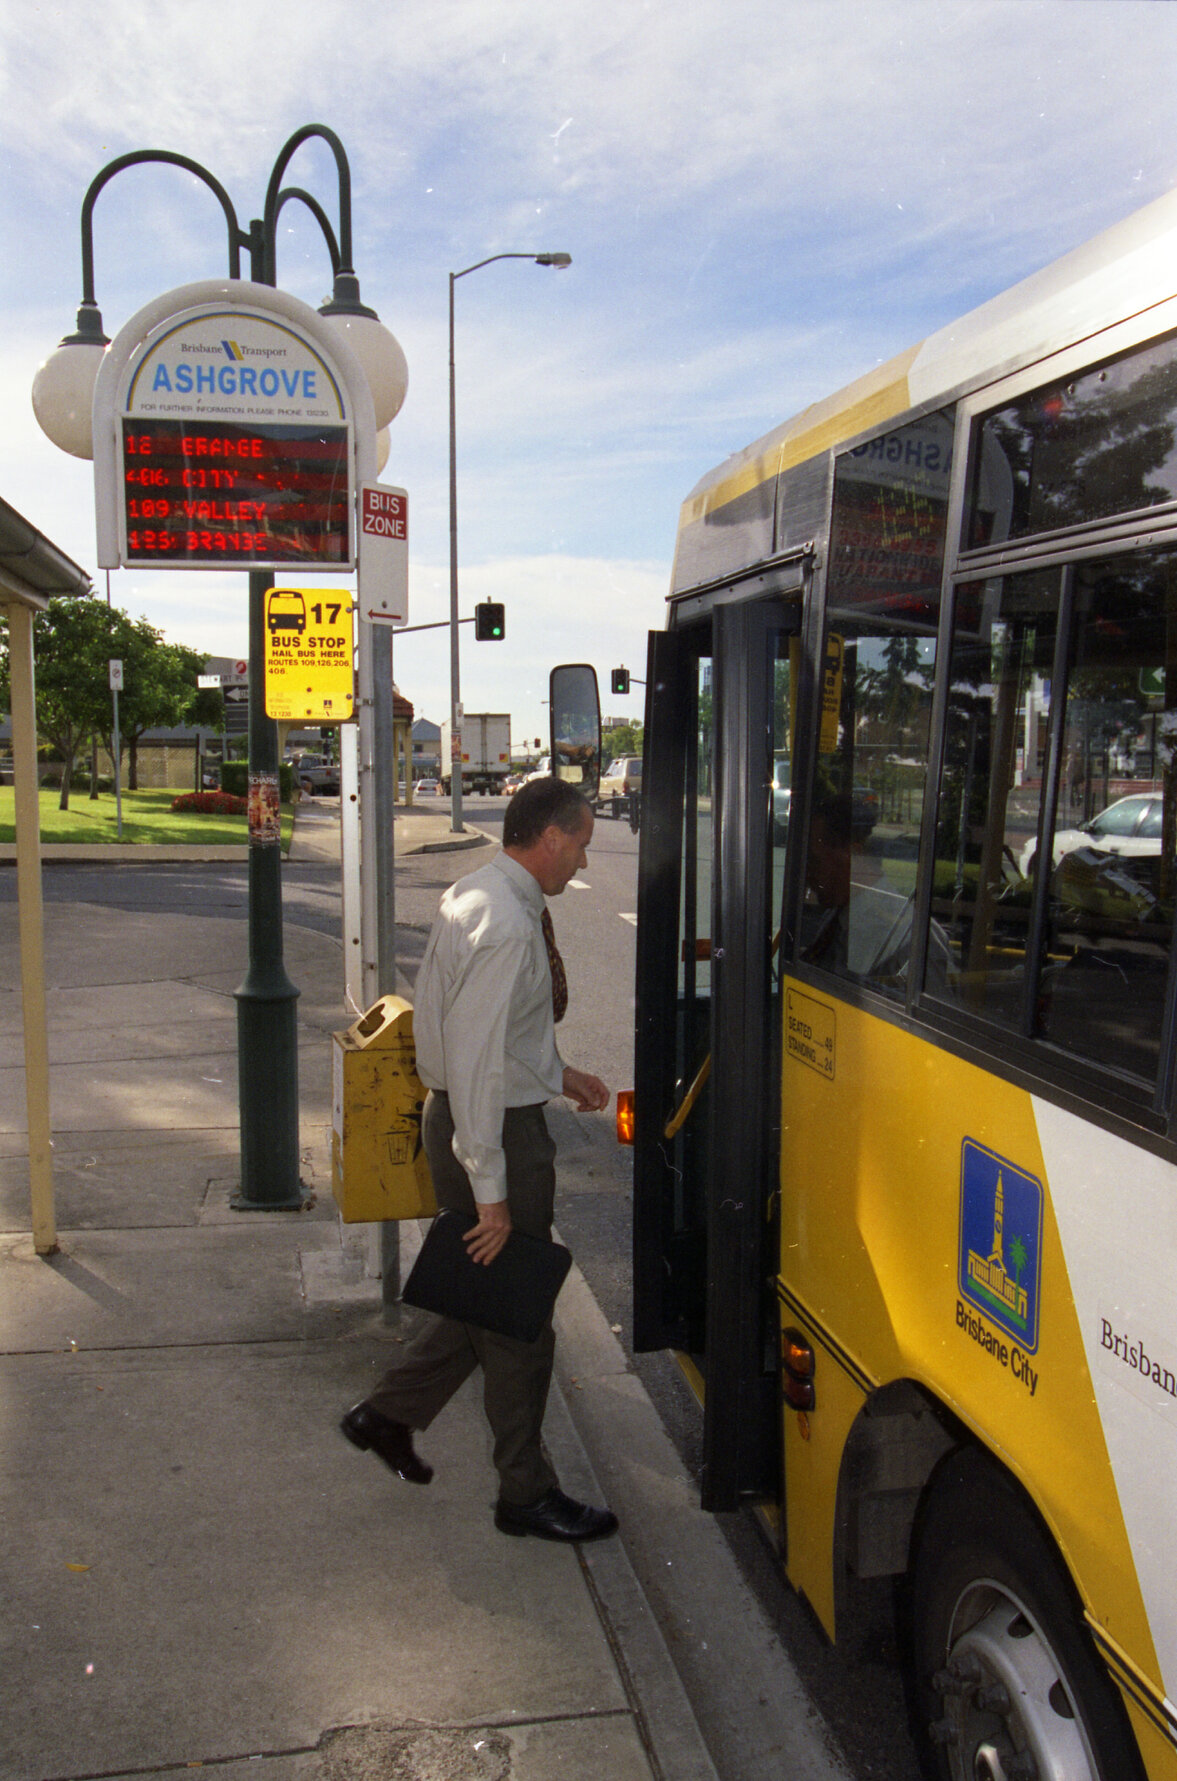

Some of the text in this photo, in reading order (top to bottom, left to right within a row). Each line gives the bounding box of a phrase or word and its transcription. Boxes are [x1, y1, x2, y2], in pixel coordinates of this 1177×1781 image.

[181, 343, 287, 359] Brisbane Transport
[152, 363, 317, 399] ASHGROVE
[141, 403, 157, 411] FOR
[159, 404, 193, 412] FURTHER
[196, 405, 245, 414] INFORMATION
[247, 407, 274, 416] PLEASE
[277, 408, 302, 417] PHONE
[129, 499, 267, 520] 109 VALLEY
[369, 492, 400, 515] BUS
[364, 513, 405, 538] ZONE
[310, 603, 342, 624] 17
[271, 636, 346, 648] BUS STOP
[272, 650, 294, 658] HAIL
[297, 650, 316, 658] BUS
[788, 1015, 812, 1040] SEATED
[788, 1034, 816, 1063] STANDING
[956, 1299, 1038, 1397] Brisbane City
[1101, 1317, 1177, 1399] Brisban
